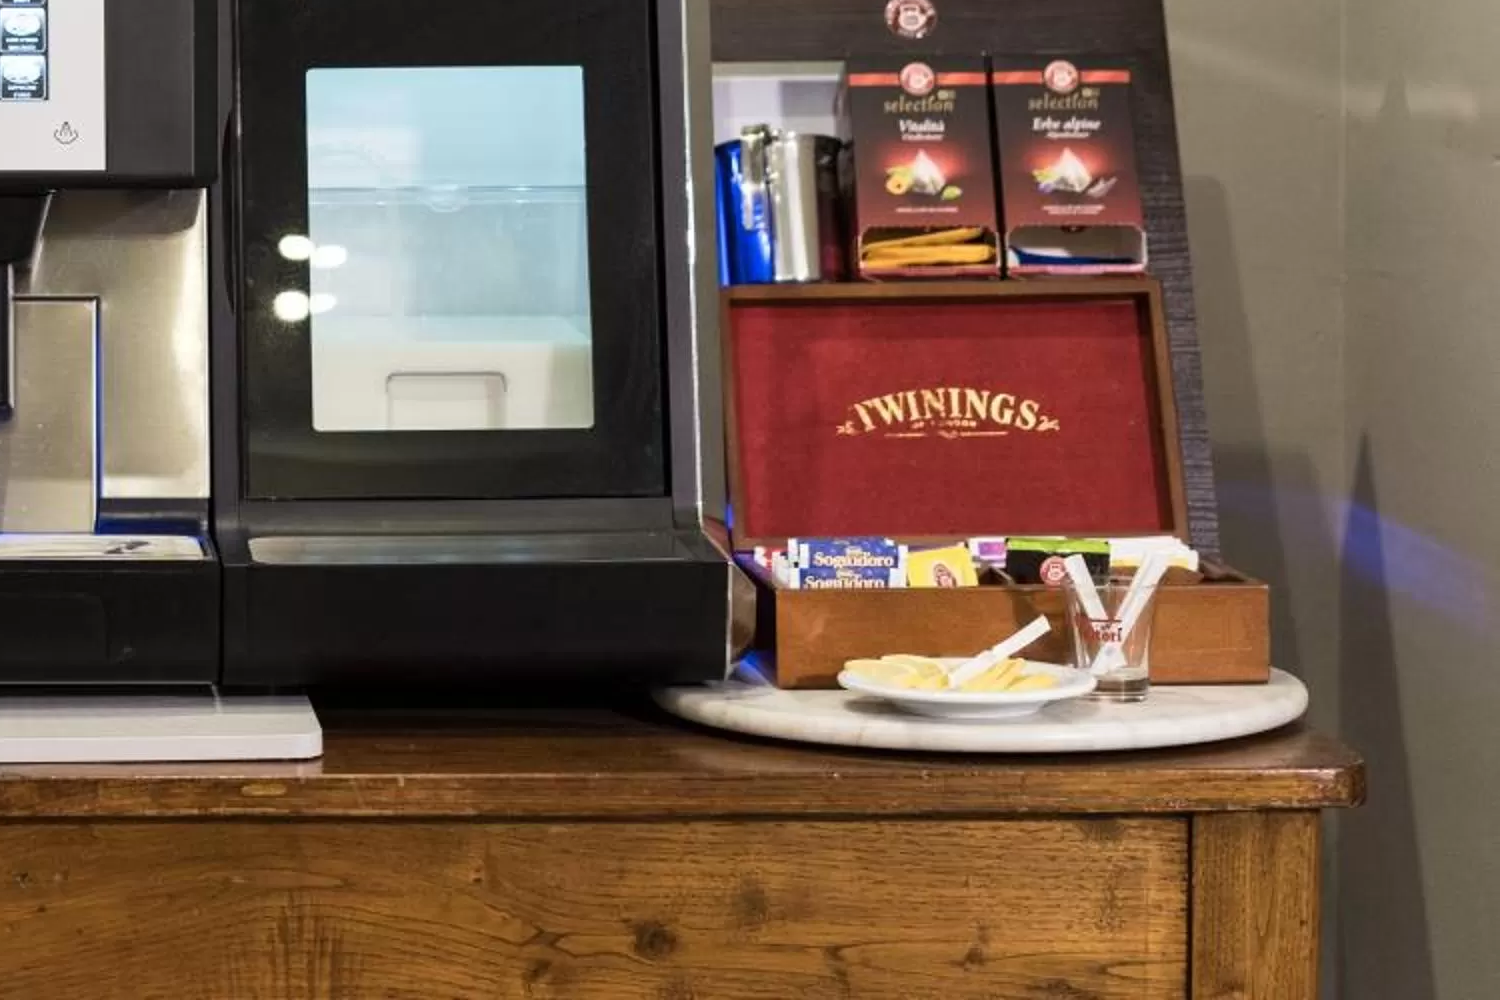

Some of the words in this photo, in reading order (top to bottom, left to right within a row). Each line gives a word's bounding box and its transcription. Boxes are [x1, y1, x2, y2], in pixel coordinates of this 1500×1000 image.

[883, 94, 954, 113] selection
[1027, 91, 1099, 111] selection
[853, 387, 1040, 432] TWININGS
